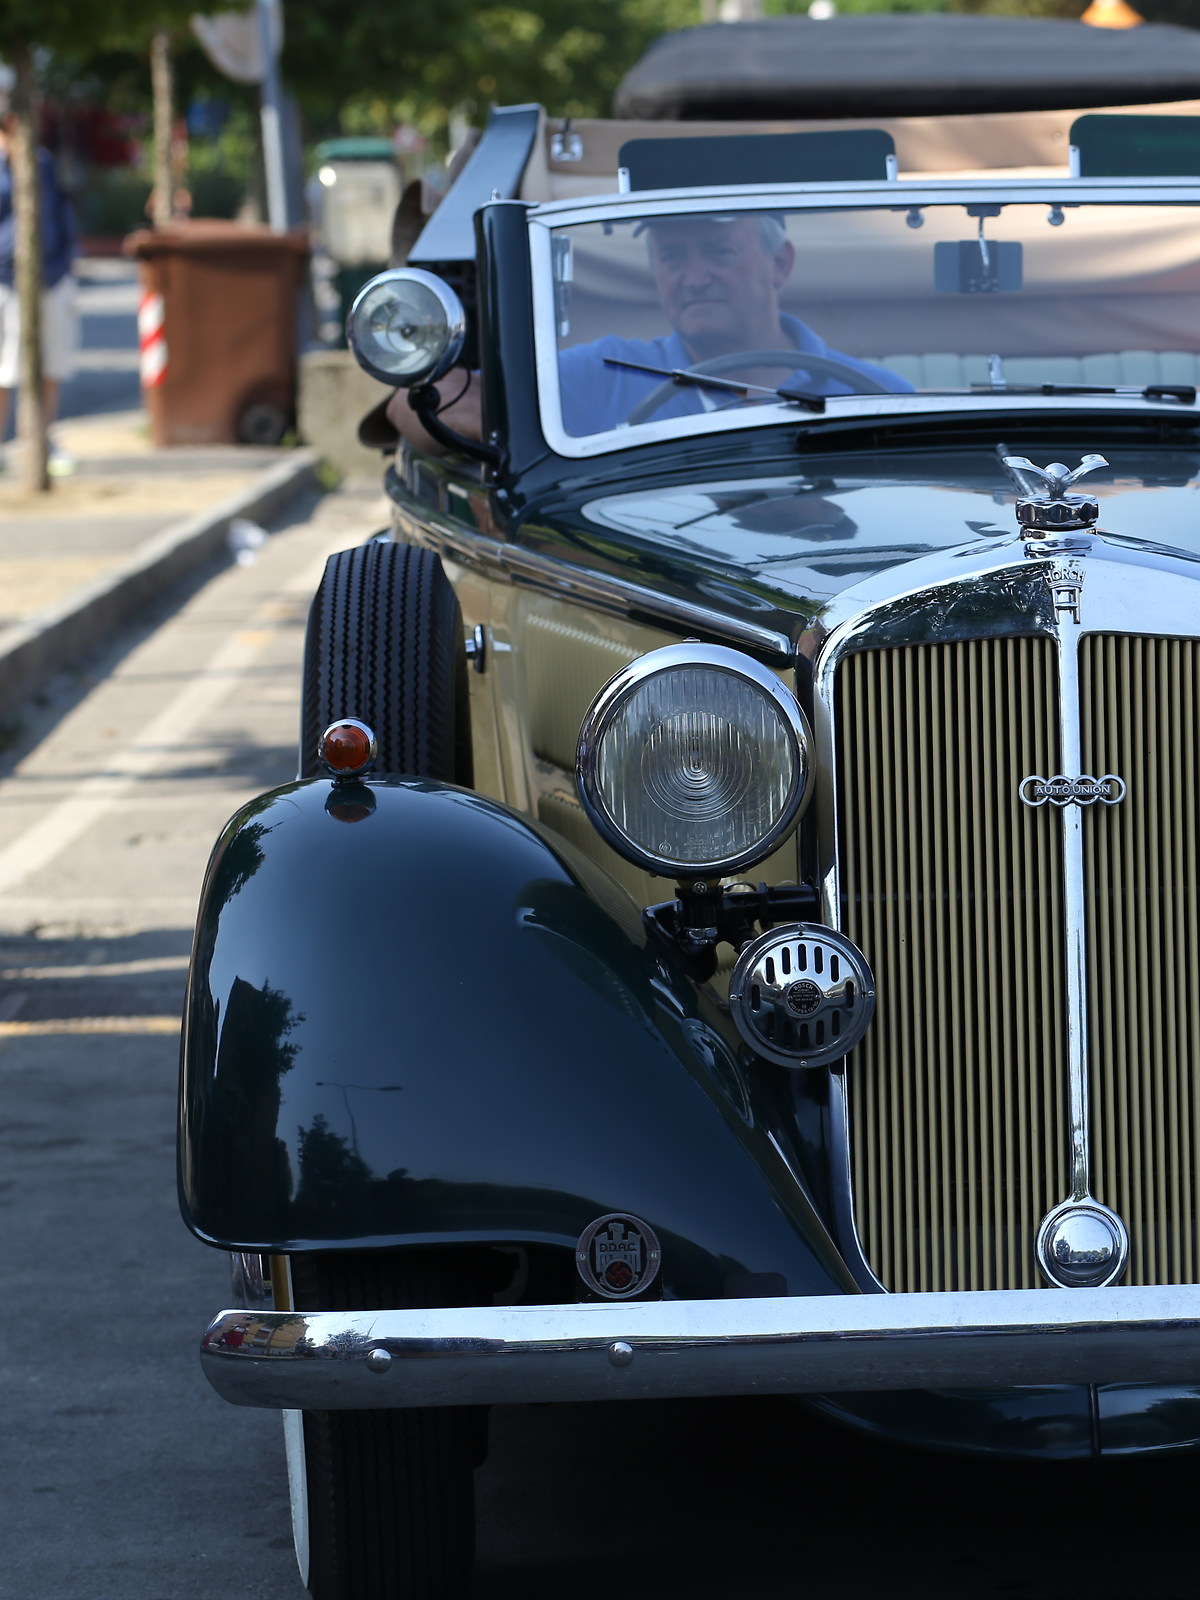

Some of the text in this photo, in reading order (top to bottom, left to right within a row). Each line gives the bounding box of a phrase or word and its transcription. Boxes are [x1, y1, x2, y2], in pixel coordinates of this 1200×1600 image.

[1043, 567, 1086, 583] HORCH
[1037, 785, 1110, 794] AUTO UNION
